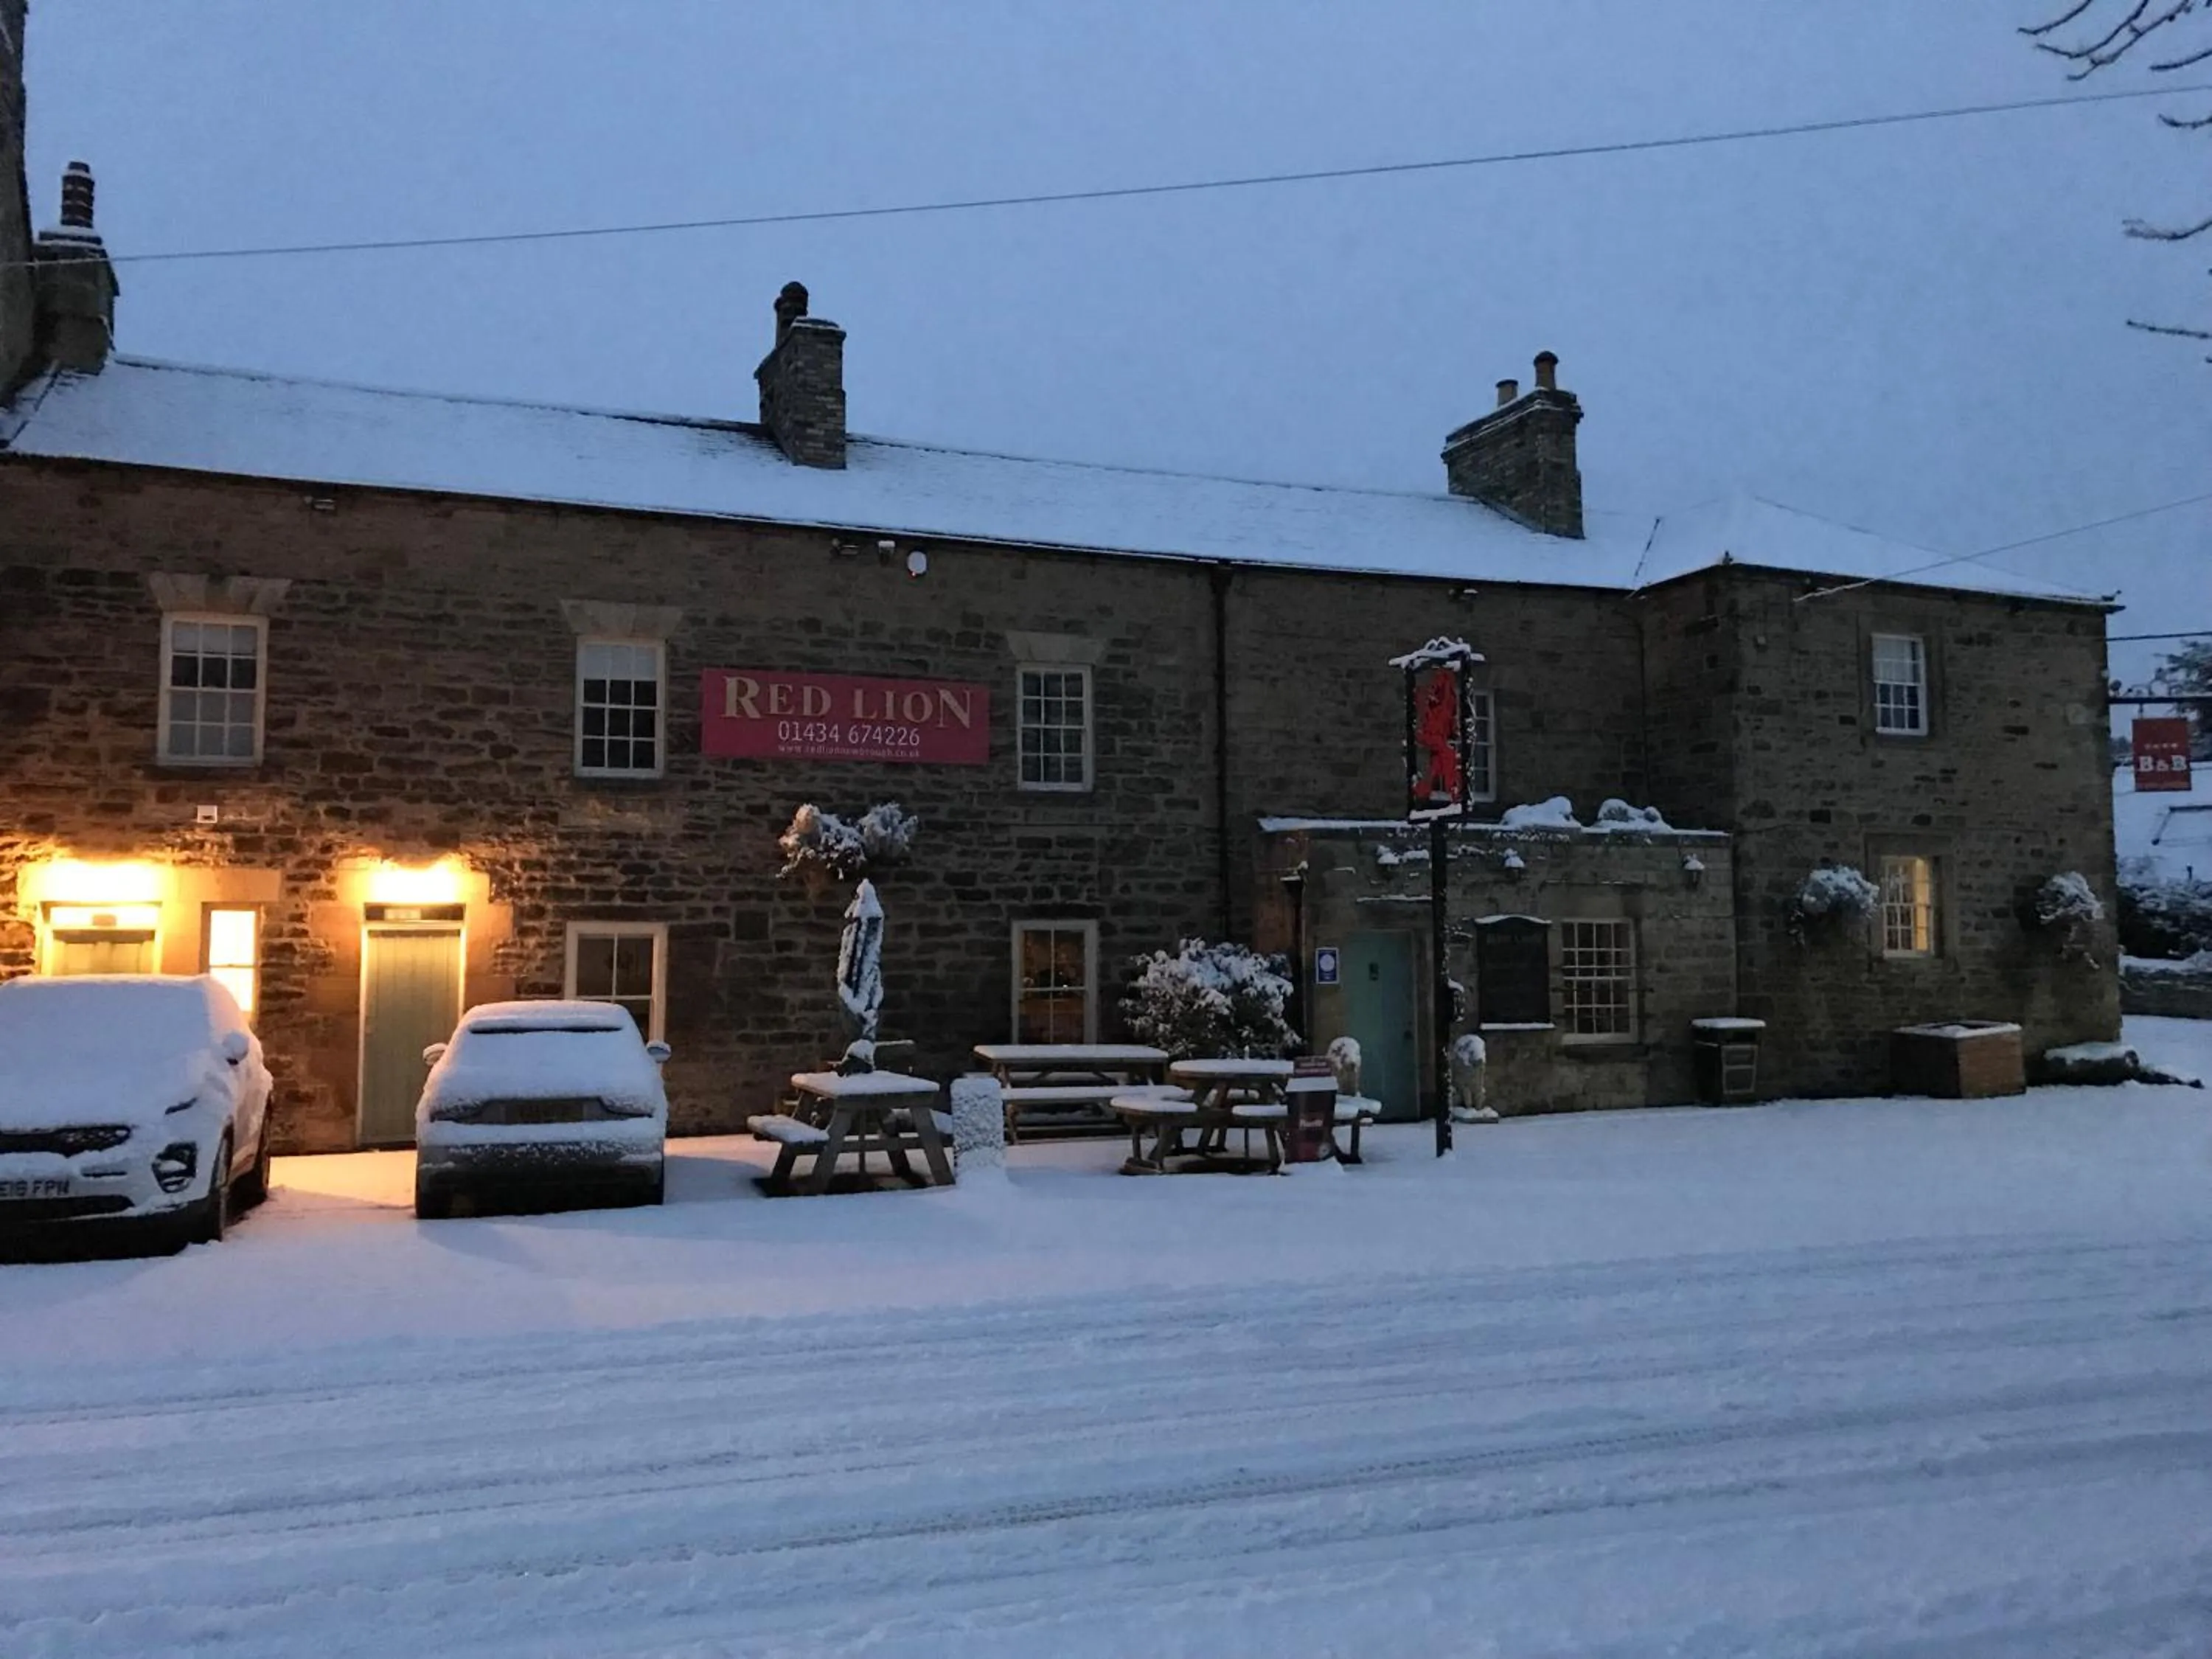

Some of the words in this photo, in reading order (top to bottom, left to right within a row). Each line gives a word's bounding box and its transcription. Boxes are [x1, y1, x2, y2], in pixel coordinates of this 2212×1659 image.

[720, 675, 832, 719] RED
[853, 686, 973, 728] LION
[778, 720, 840, 743] 01434
[848, 724, 920, 746] 674226
